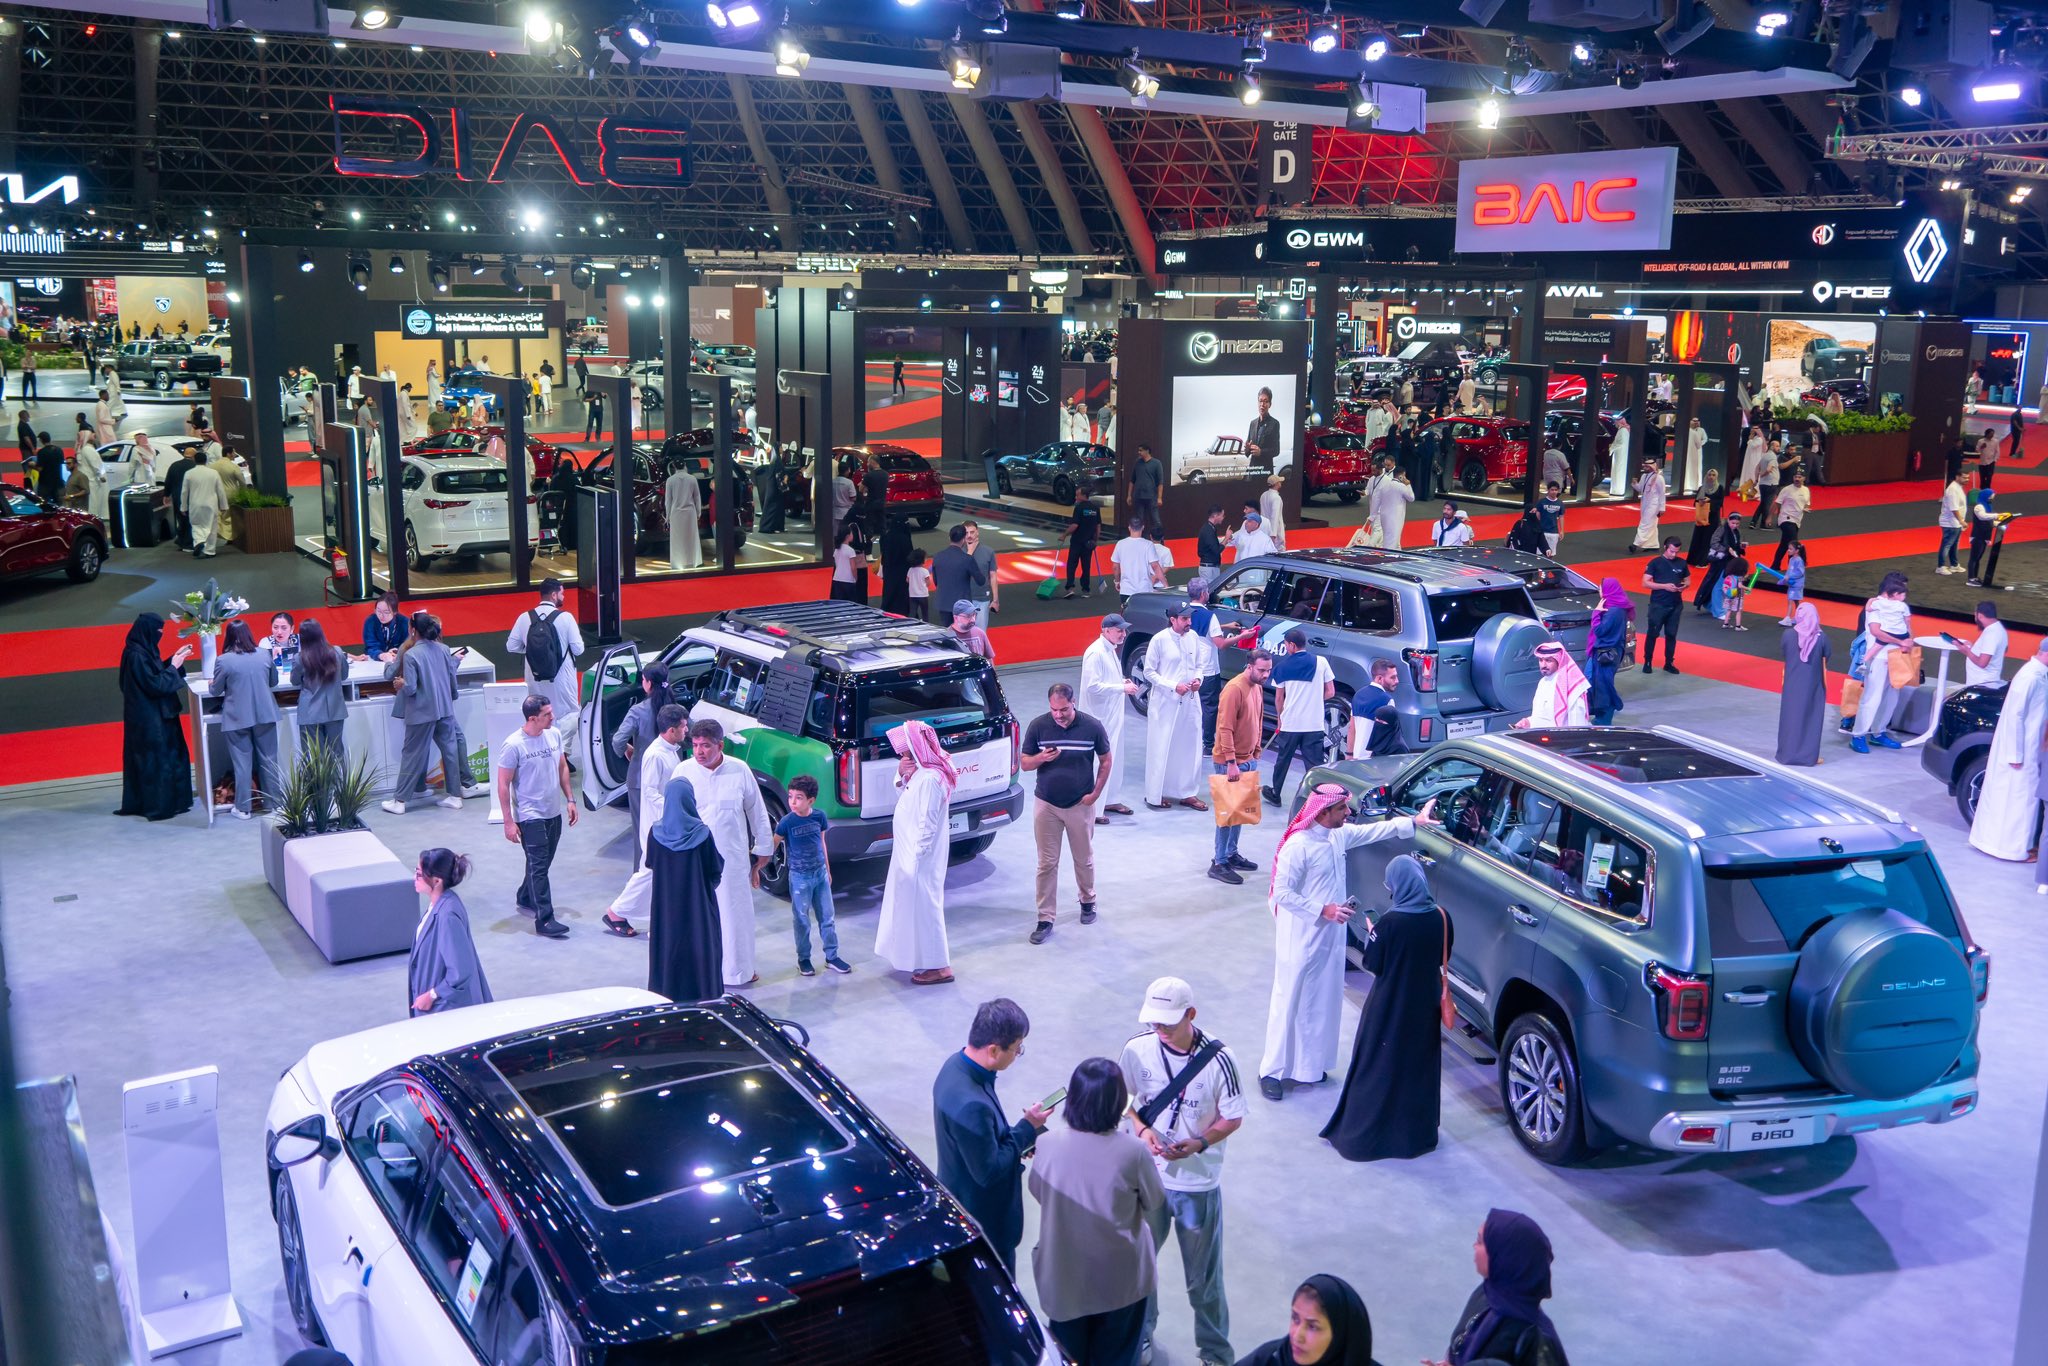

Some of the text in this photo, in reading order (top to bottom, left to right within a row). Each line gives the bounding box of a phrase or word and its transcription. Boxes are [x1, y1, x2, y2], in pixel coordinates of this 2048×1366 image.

[1274, 130, 1297, 140] GATE
[1273, 149, 1296, 184] D
[1473, 177, 1638, 226] BAIC
[1314, 232, 1363, 246] GWM
[1171, 251, 1186, 263] GWM
[796, 257, 862, 272] GEELY
[1678, 263, 1706, 272] OFF-ROAD
[1712, 262, 1737, 271] GLOBAL,
[1751, 262, 1772, 270] WITHIN
[436, 324, 452, 332] Haji
[530, 323, 544, 331] Ltd.
[1418, 323, 1460, 334] mazda
[1220, 339, 1283, 354] mazda
[1936, 349, 1964, 357] mazda
[1720, 1066, 1750, 1074] BJ60
[1718, 1076, 1743, 1084] BAIC
[1751, 1129, 1794, 1141] BJ60
